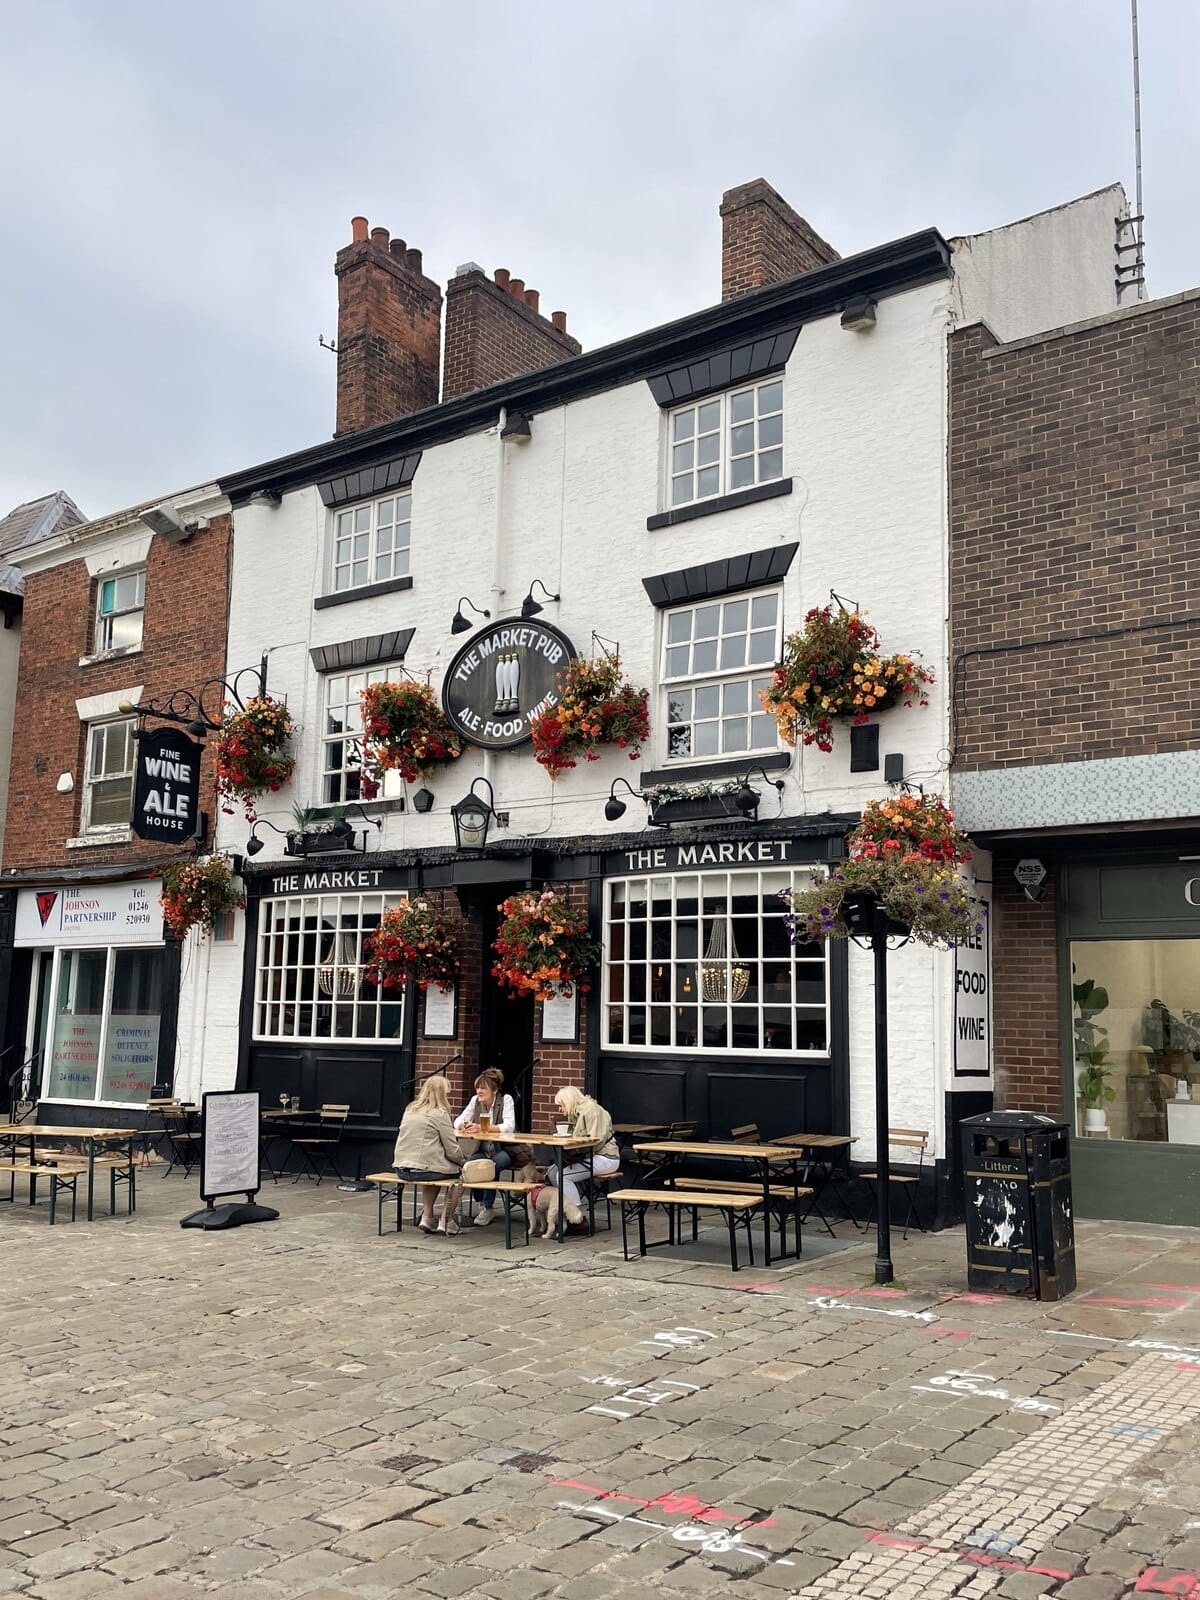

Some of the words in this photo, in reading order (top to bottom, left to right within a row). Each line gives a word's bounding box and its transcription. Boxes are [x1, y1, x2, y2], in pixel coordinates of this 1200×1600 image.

[455, 650, 480, 681] THE
[478, 628, 538, 659] MARKET
[535, 635, 563, 664] PUB
[458, 707, 482, 731] ALE
[483, 718, 523, 738] FOOD
[160, 748, 181, 760] FINE
[144, 756, 192, 784] WINE
[164, 782, 171, 791] &
[143, 789, 190, 819] ALE
[146, 816, 184, 830] HOUSE
[625, 847, 667, 870] THE
[677, 840, 792, 866] MARKET
[1018, 865, 1041, 873] NSS
[272, 875, 299, 893] THE
[303, 869, 383, 889] MARKET
[65, 888, 81, 898] THE
[132, 888, 146, 898] Tel:
[64, 900, 100, 911] JOHNSON
[128, 901, 149, 911] 01246
[64, 911, 117, 923] PARTNERSHIP
[126, 913, 151, 924] 520930
[956, 970, 987, 994] FOOD
[72, 1027, 86, 1036] THE
[116, 1028, 151, 1038] CRIMINAL
[958, 1016, 985, 1041] WINE
[111, 1054, 154, 1063] SOLICITORS
[984, 1160, 1012, 1172] Litter
